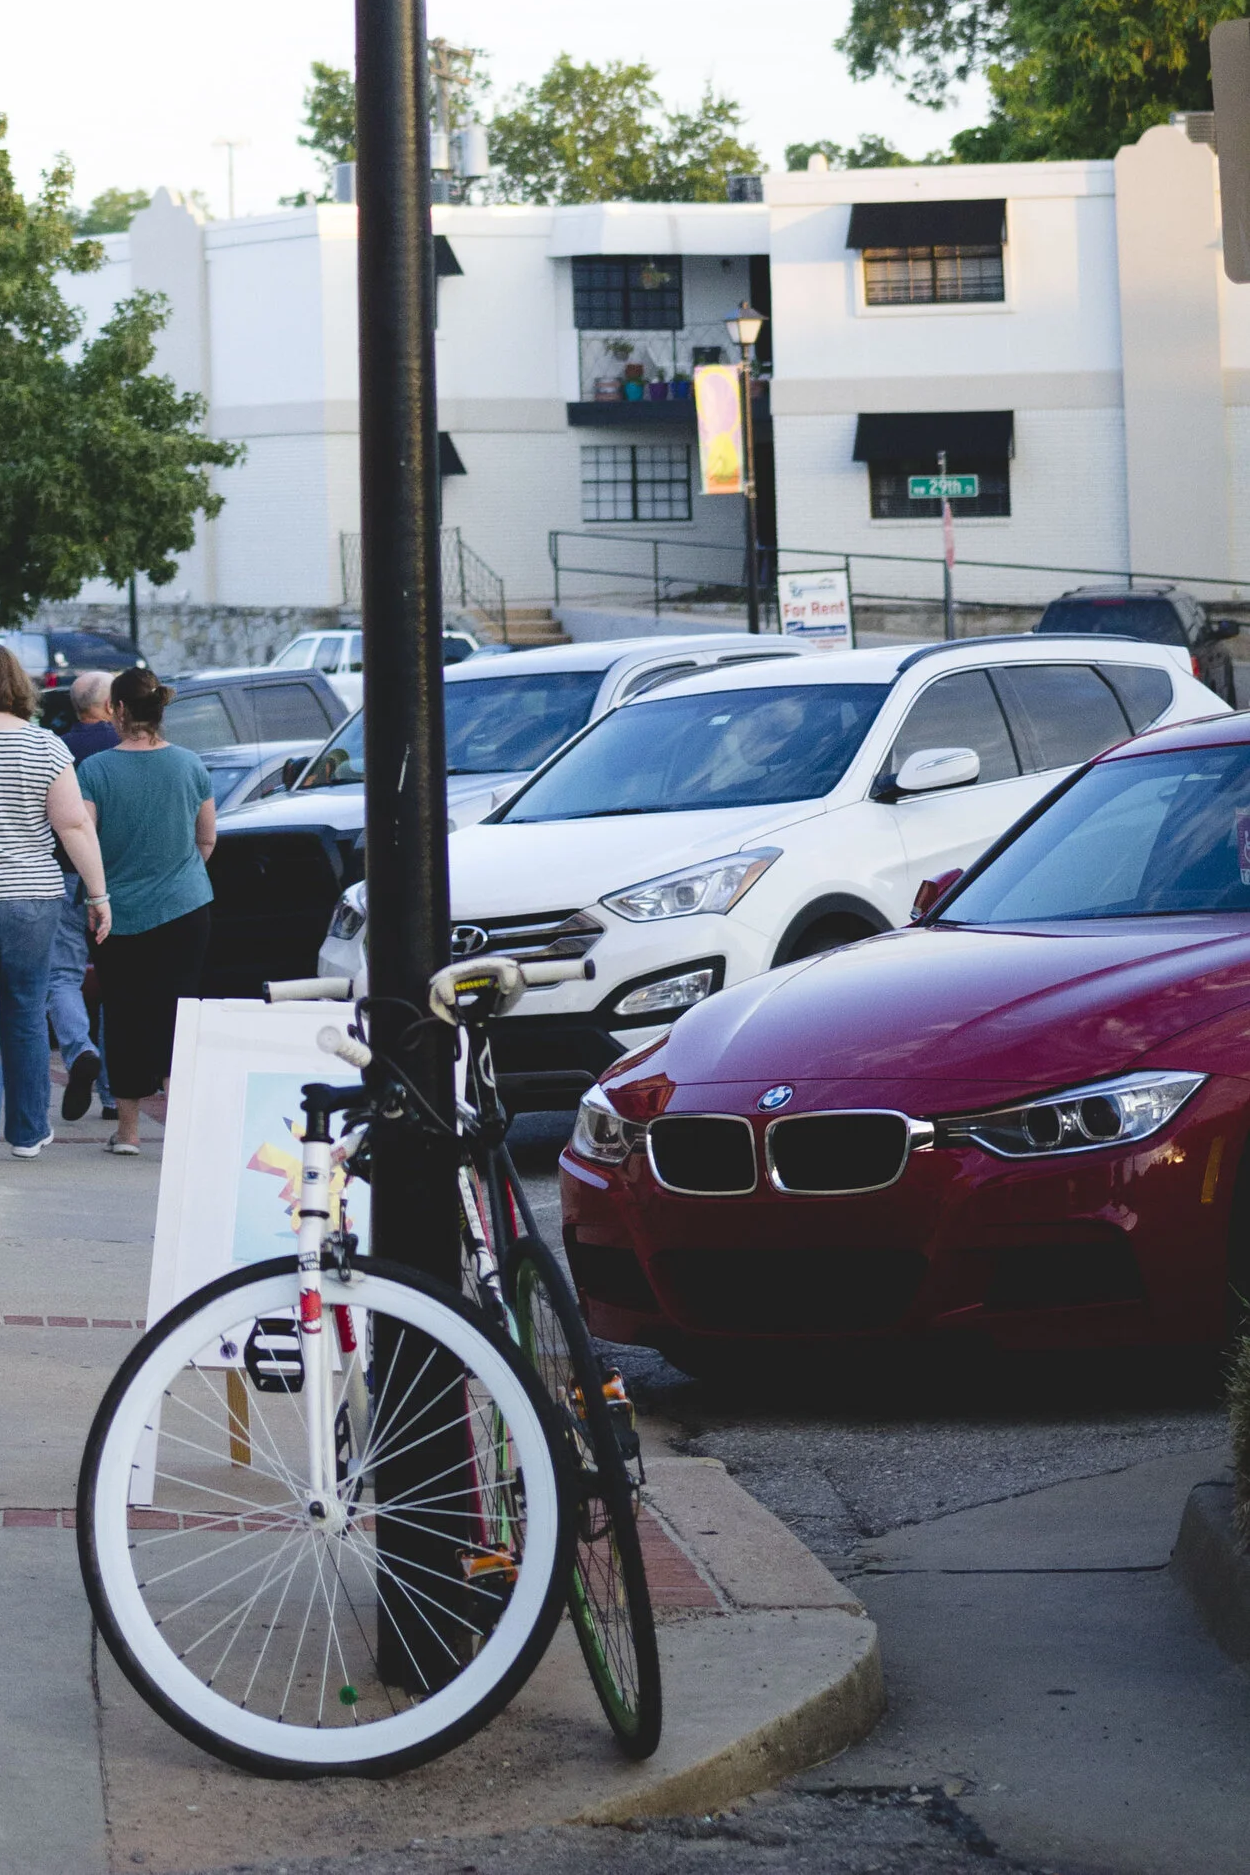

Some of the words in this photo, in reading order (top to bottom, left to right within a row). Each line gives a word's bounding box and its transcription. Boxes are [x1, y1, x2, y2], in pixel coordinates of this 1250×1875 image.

[929, 478, 962, 495] 29th
[784, 603, 806, 617] For
[811, 600, 845, 616] Rent
